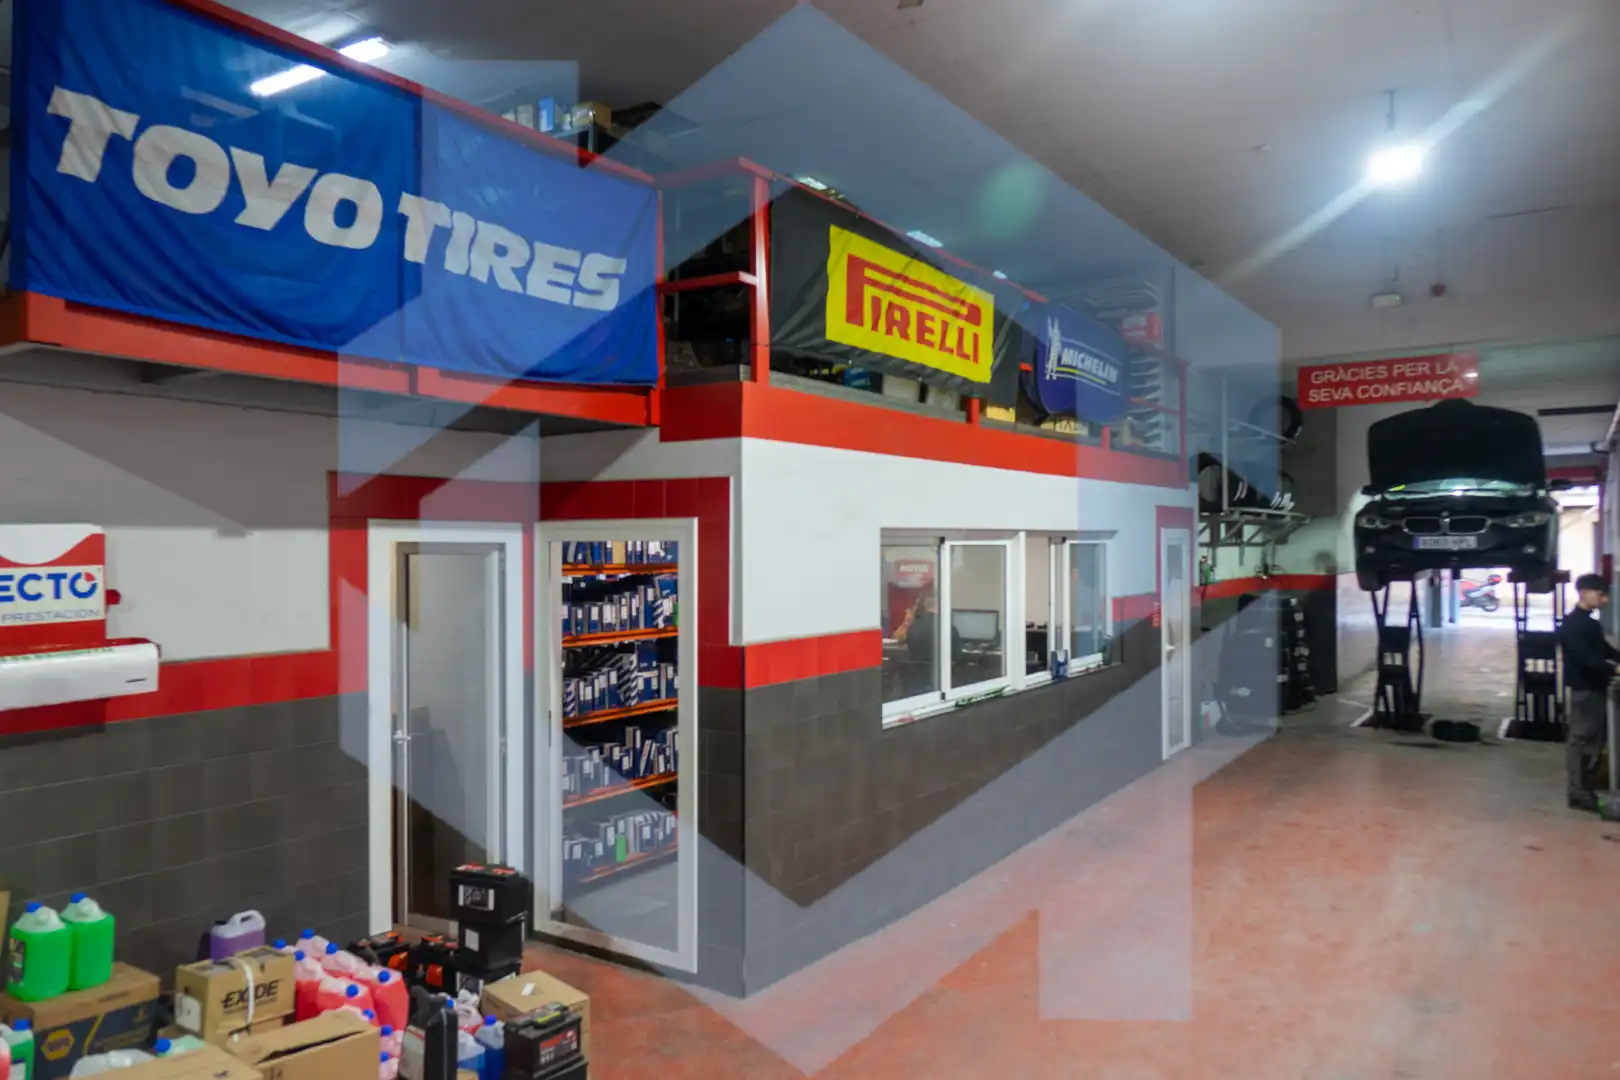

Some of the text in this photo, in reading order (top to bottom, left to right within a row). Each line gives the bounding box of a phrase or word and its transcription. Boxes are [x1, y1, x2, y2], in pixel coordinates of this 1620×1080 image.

[47, 86, 626, 311] TOYO TIRES
[846, 252, 982, 364] PIRELLI
[1061, 348, 1118, 383] MICHELIN
[1310, 359, 1459, 384] GRÀCIES PER LA
[1308, 378, 1465, 402] SEVA CONFIANÇA
[222, 980, 280, 1009] EXDE
